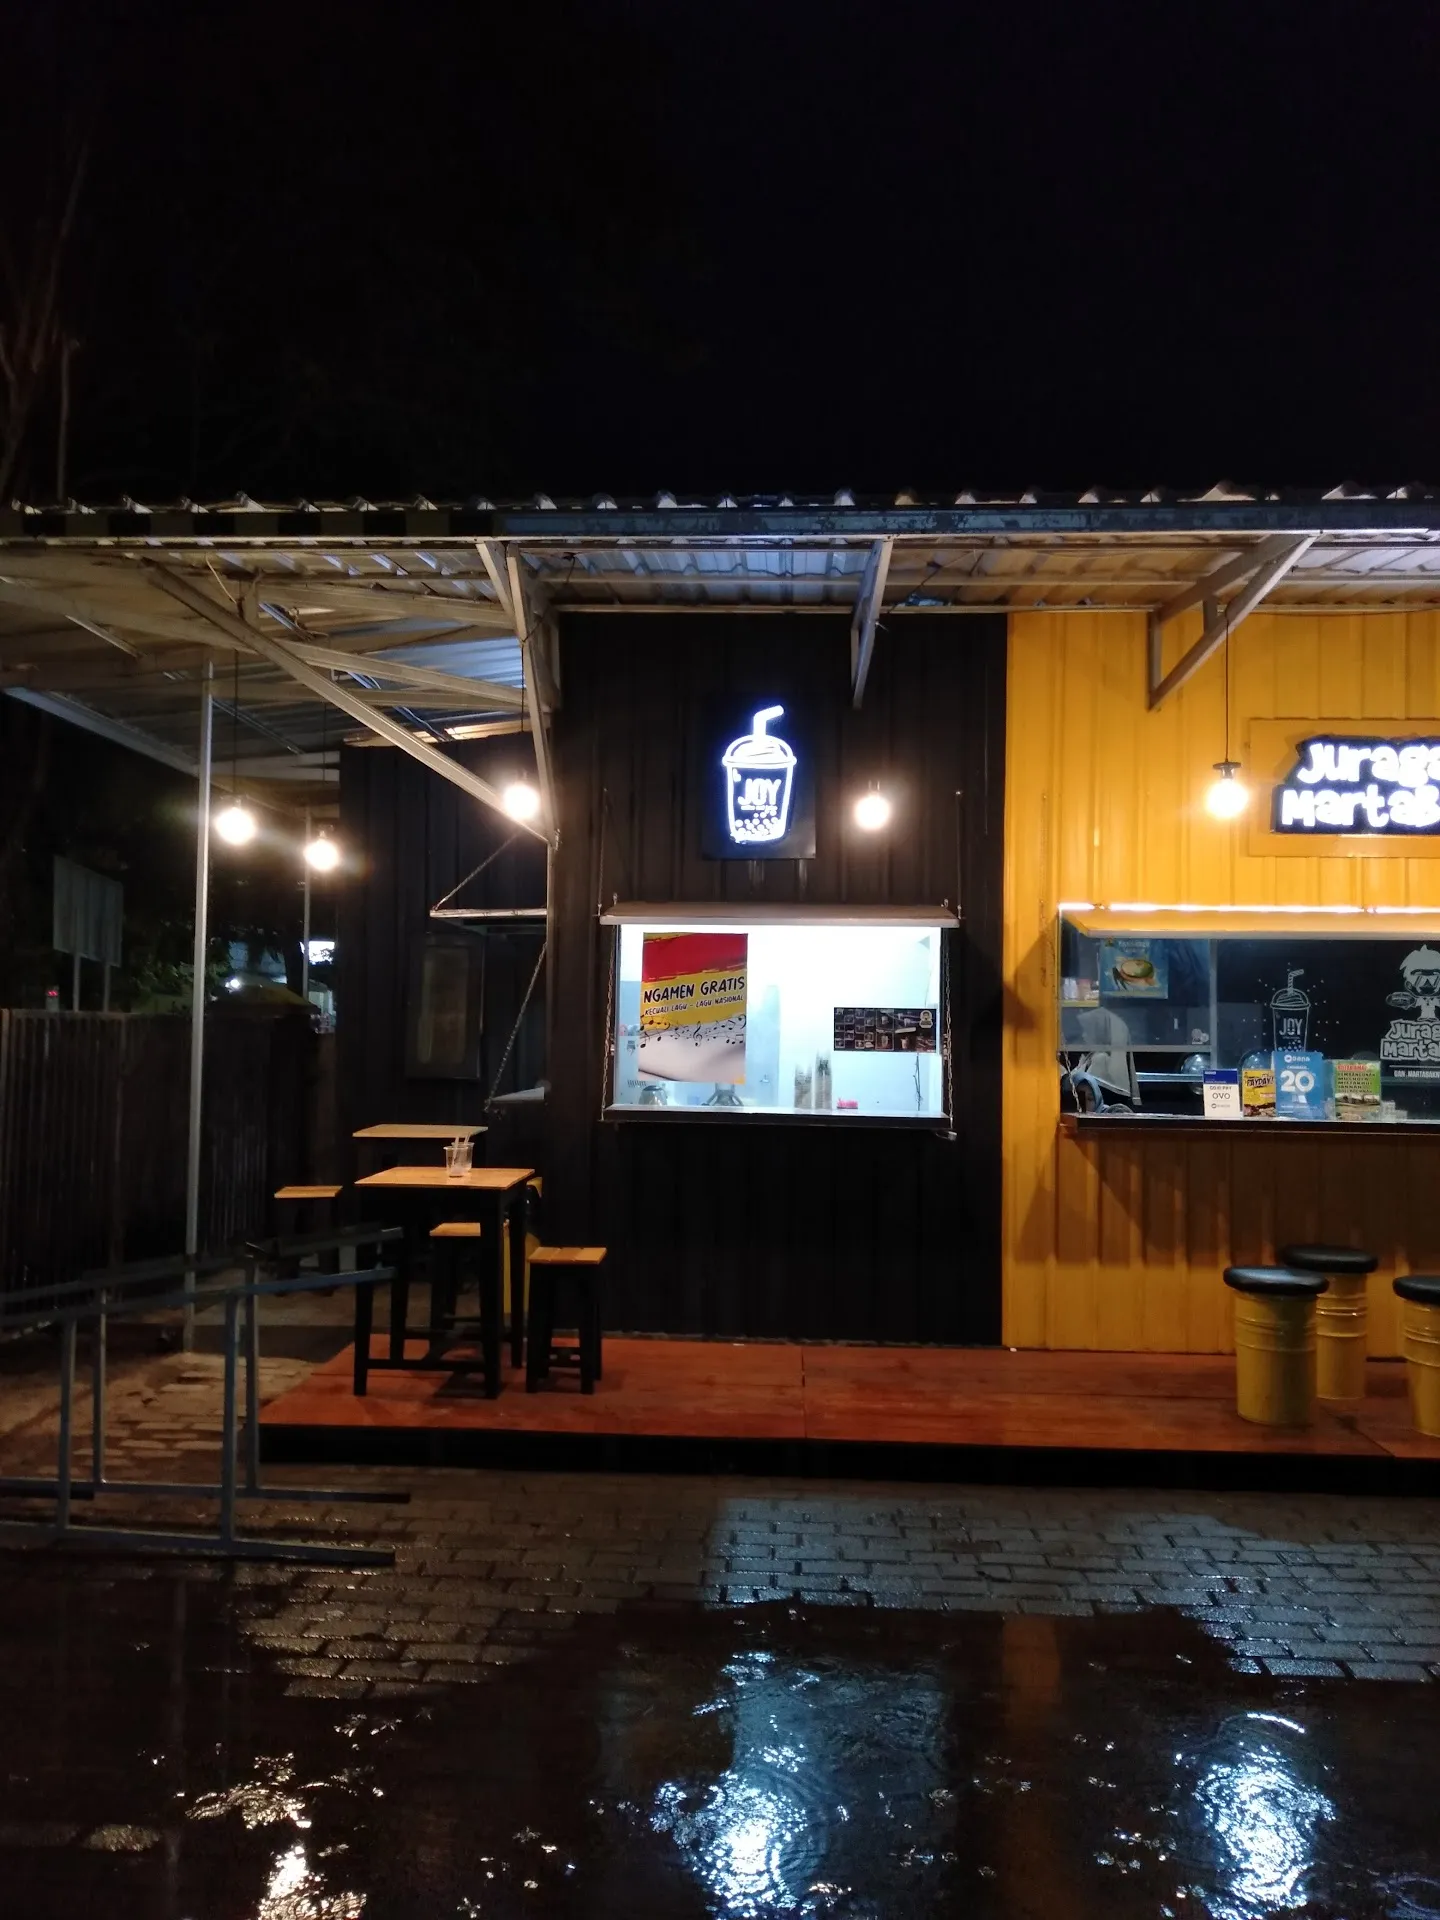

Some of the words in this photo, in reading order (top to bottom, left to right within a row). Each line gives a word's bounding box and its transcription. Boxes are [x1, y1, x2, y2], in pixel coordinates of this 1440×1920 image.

[738, 778, 782, 806] JOY
[643, 983, 695, 1003] NGAMEN
[700, 976, 745, 995] GRATIS
[644, 1006, 669, 1016] KECUALI
[671, 1003, 688, 1012] LAGU
[695, 999, 712, 1008] LAGU
[714, 995, 744, 1005] NASIONAL
[1279, 1017, 1303, 1036] JOY
